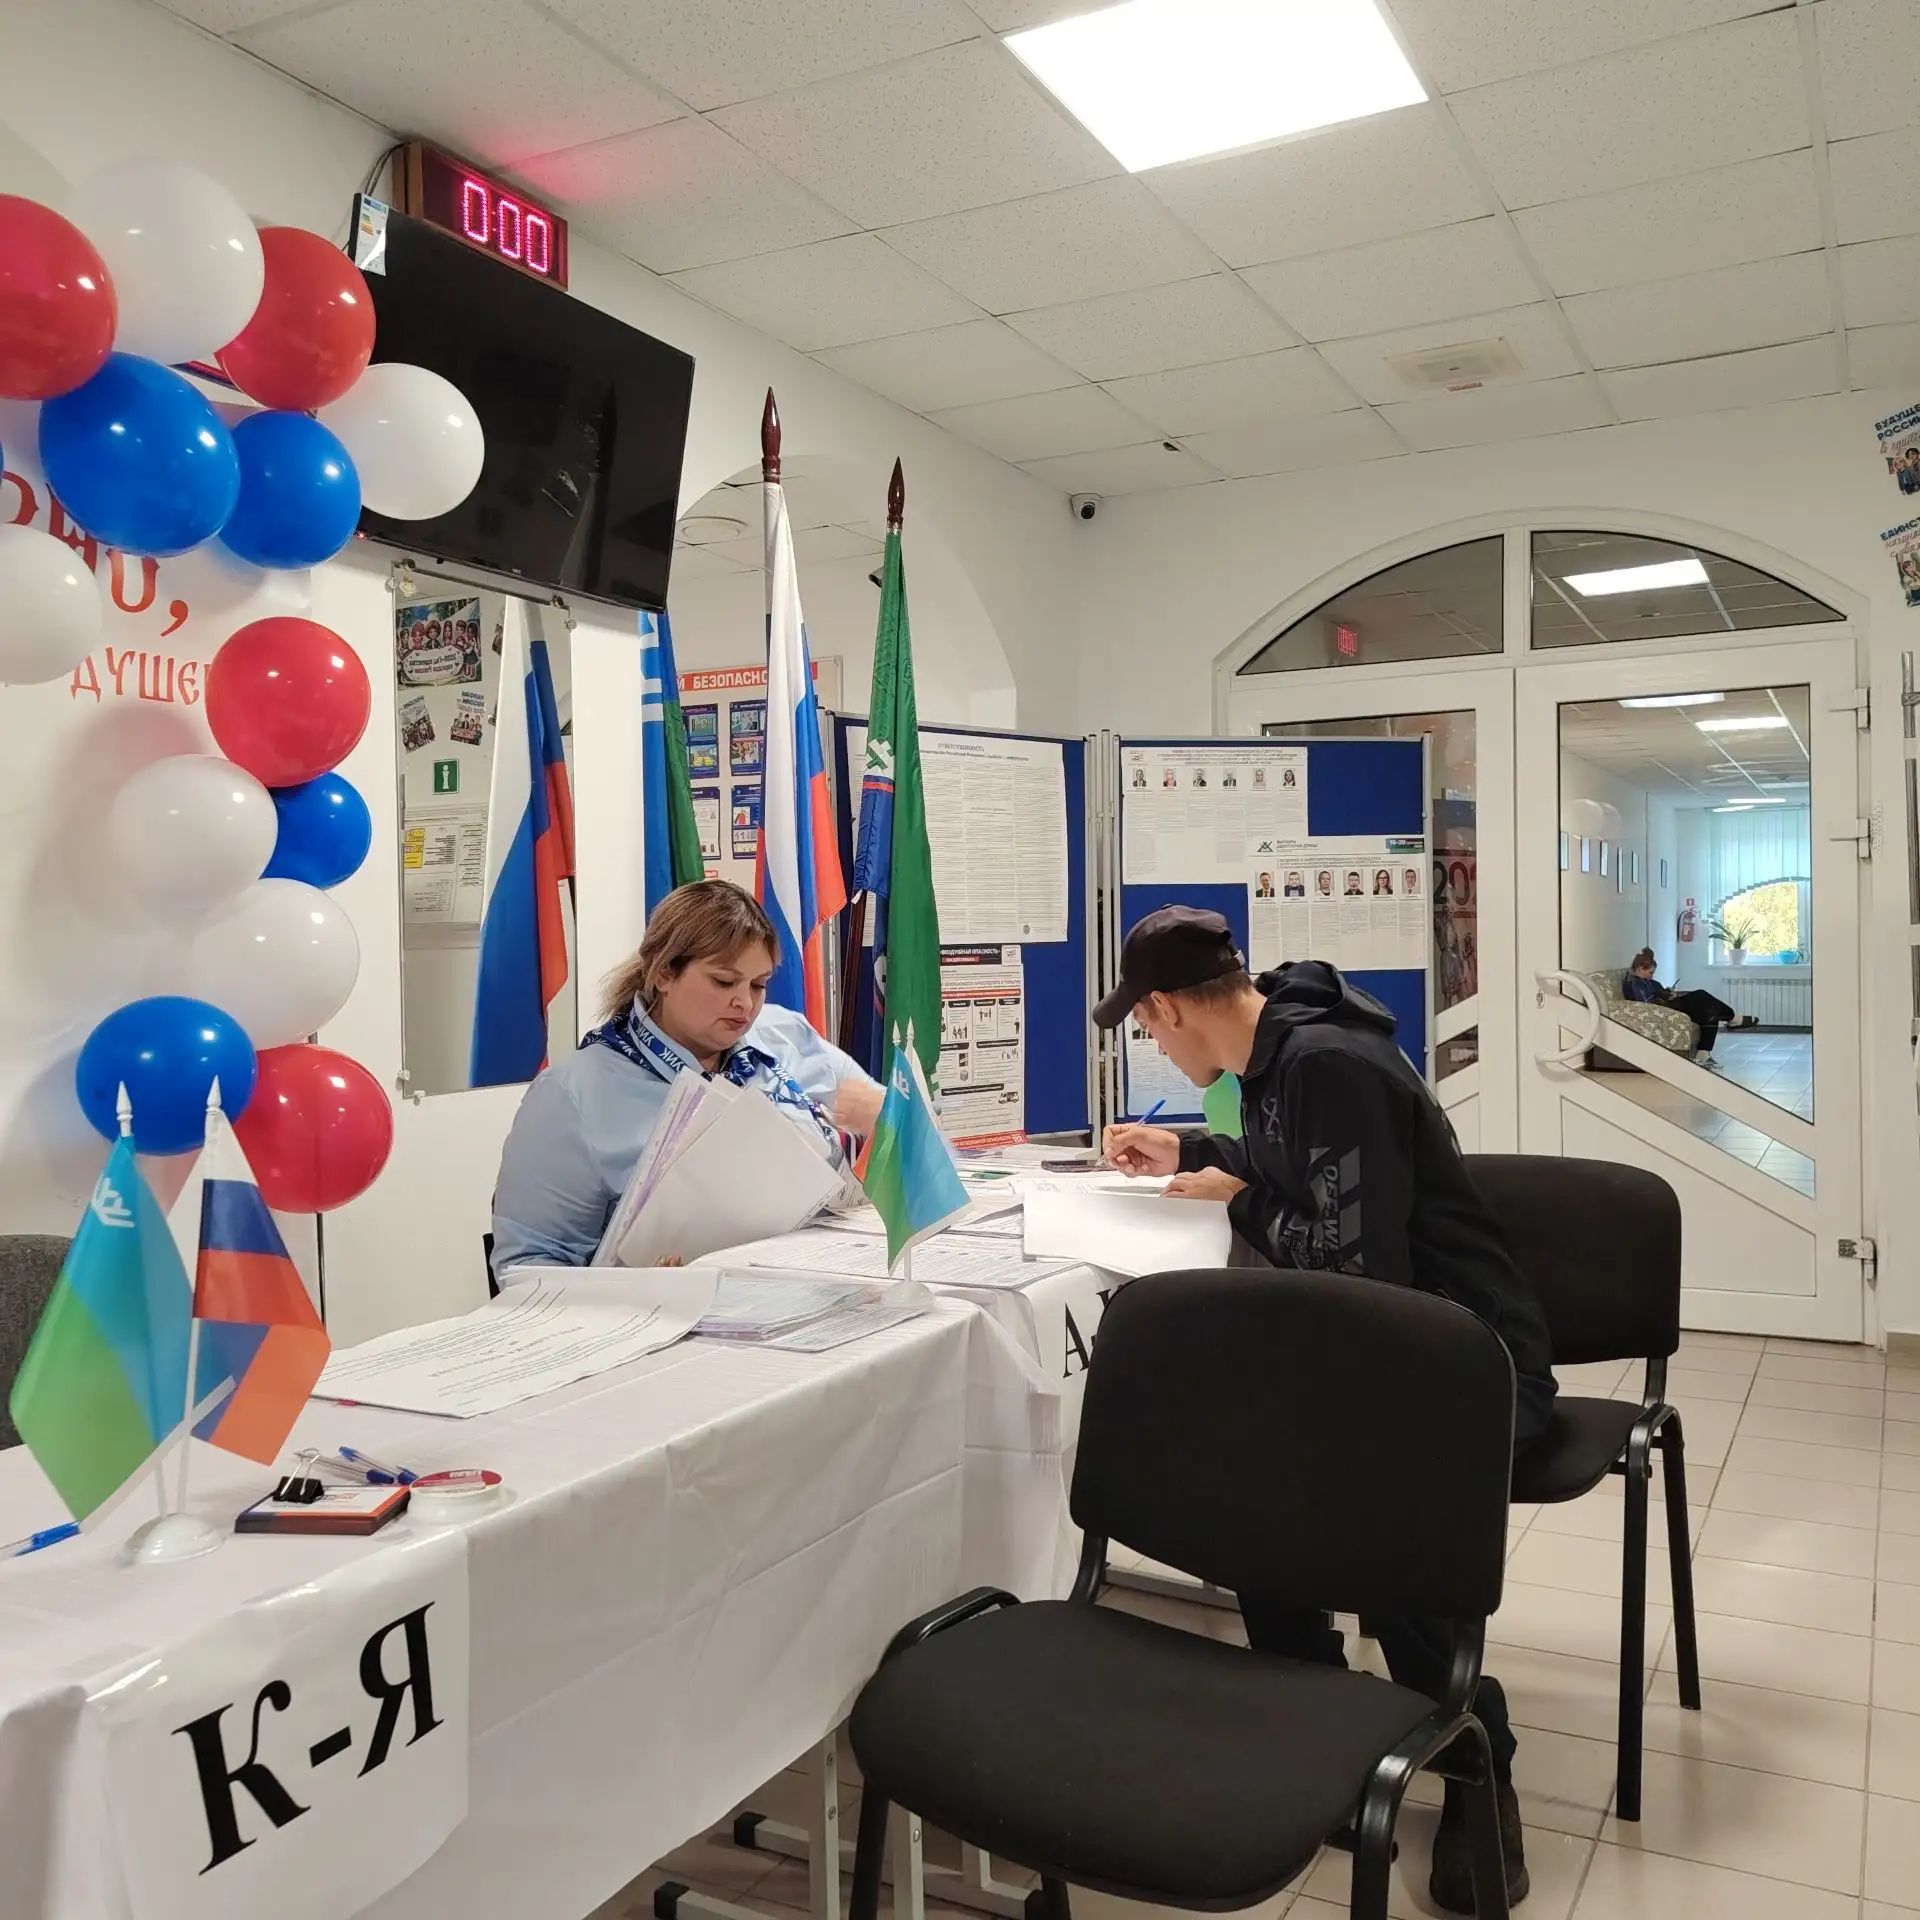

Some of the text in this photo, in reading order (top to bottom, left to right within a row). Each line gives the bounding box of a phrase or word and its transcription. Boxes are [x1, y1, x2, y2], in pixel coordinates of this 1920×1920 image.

[463, 180, 549, 273] 0:00
[71, 646, 211, 706] ДУШЕ
[659, 1046, 685, 1073] УИК
[171, 1601, 444, 1876] К-Я
